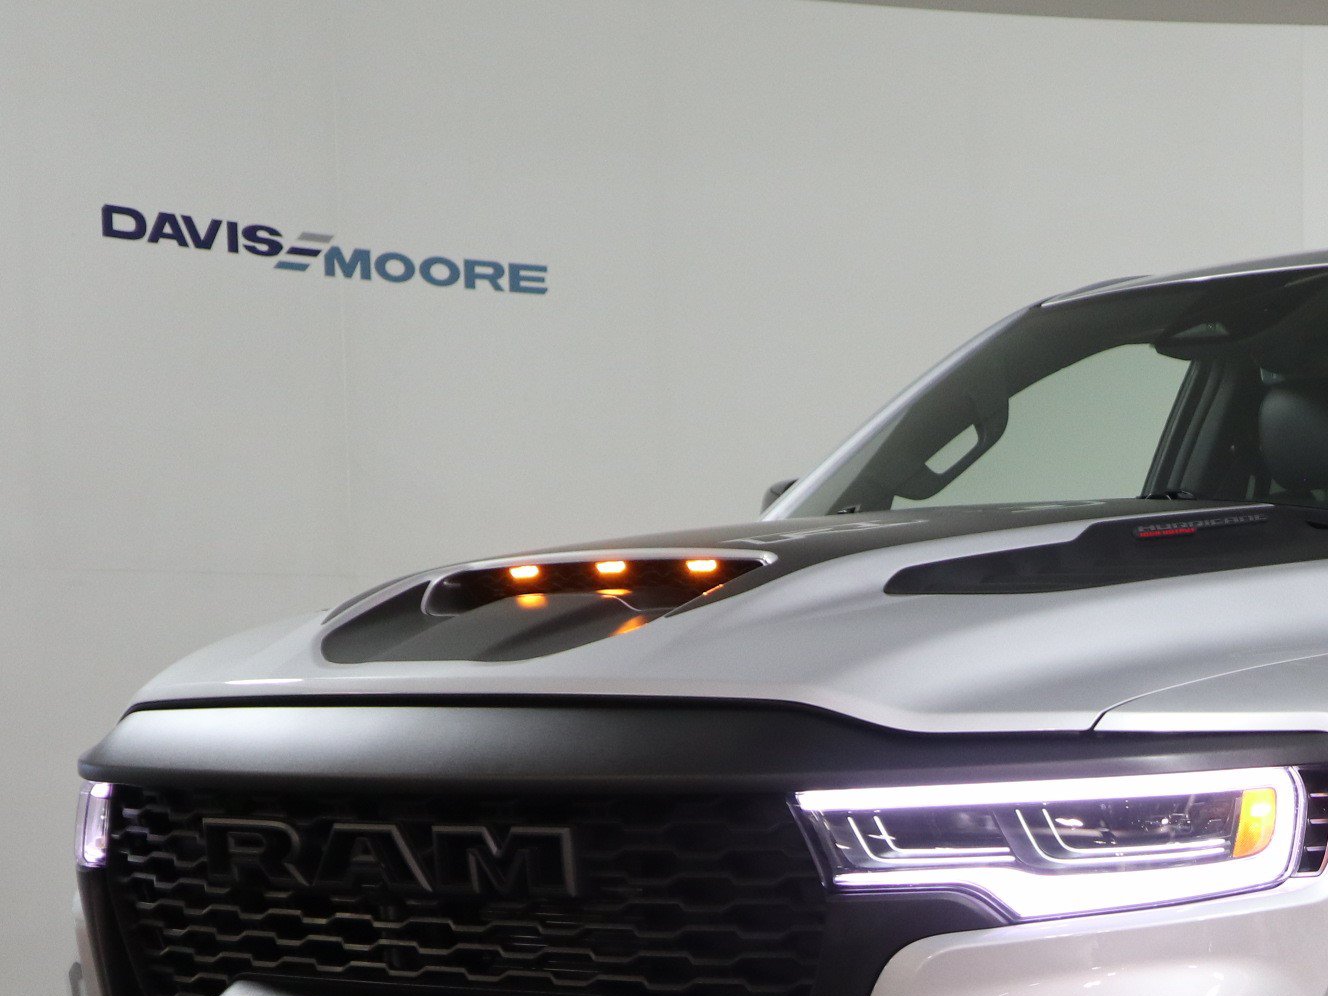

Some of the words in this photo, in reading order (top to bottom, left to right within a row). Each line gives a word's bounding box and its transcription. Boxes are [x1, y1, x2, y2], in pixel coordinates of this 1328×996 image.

[101, 203, 284, 257] DAVIS
[323, 245, 548, 295] MOORE
[202, 817, 577, 897] RAM
